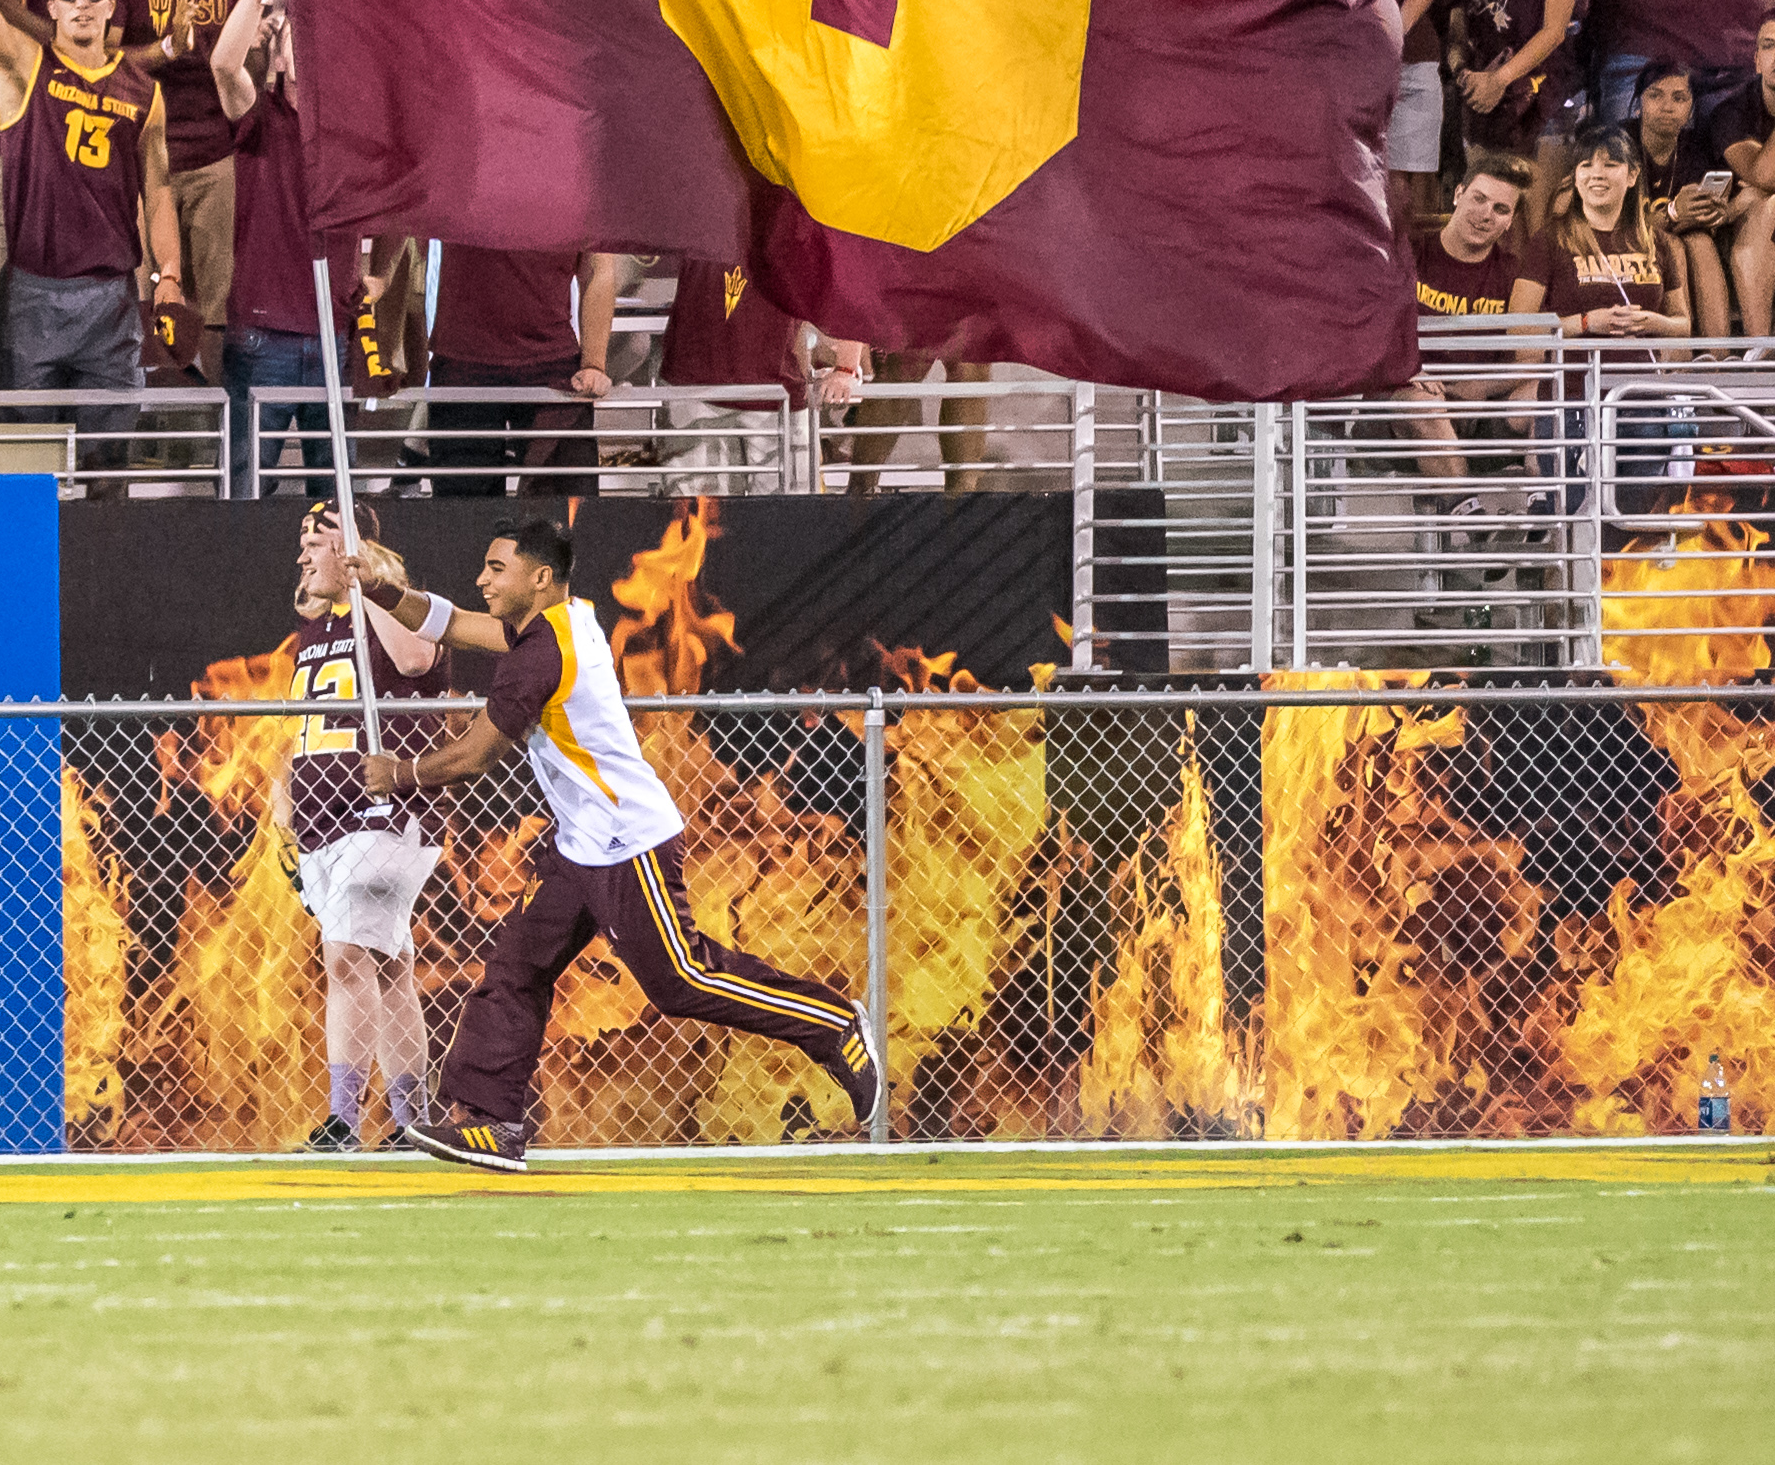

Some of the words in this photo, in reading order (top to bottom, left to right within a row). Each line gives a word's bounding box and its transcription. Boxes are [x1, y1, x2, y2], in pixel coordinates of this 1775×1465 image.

[48, 79, 97, 113] ARIZONA
[101, 97, 139, 122] STATE
[64, 108, 114, 169] 13
[1472, 297, 1507, 316] STATE
